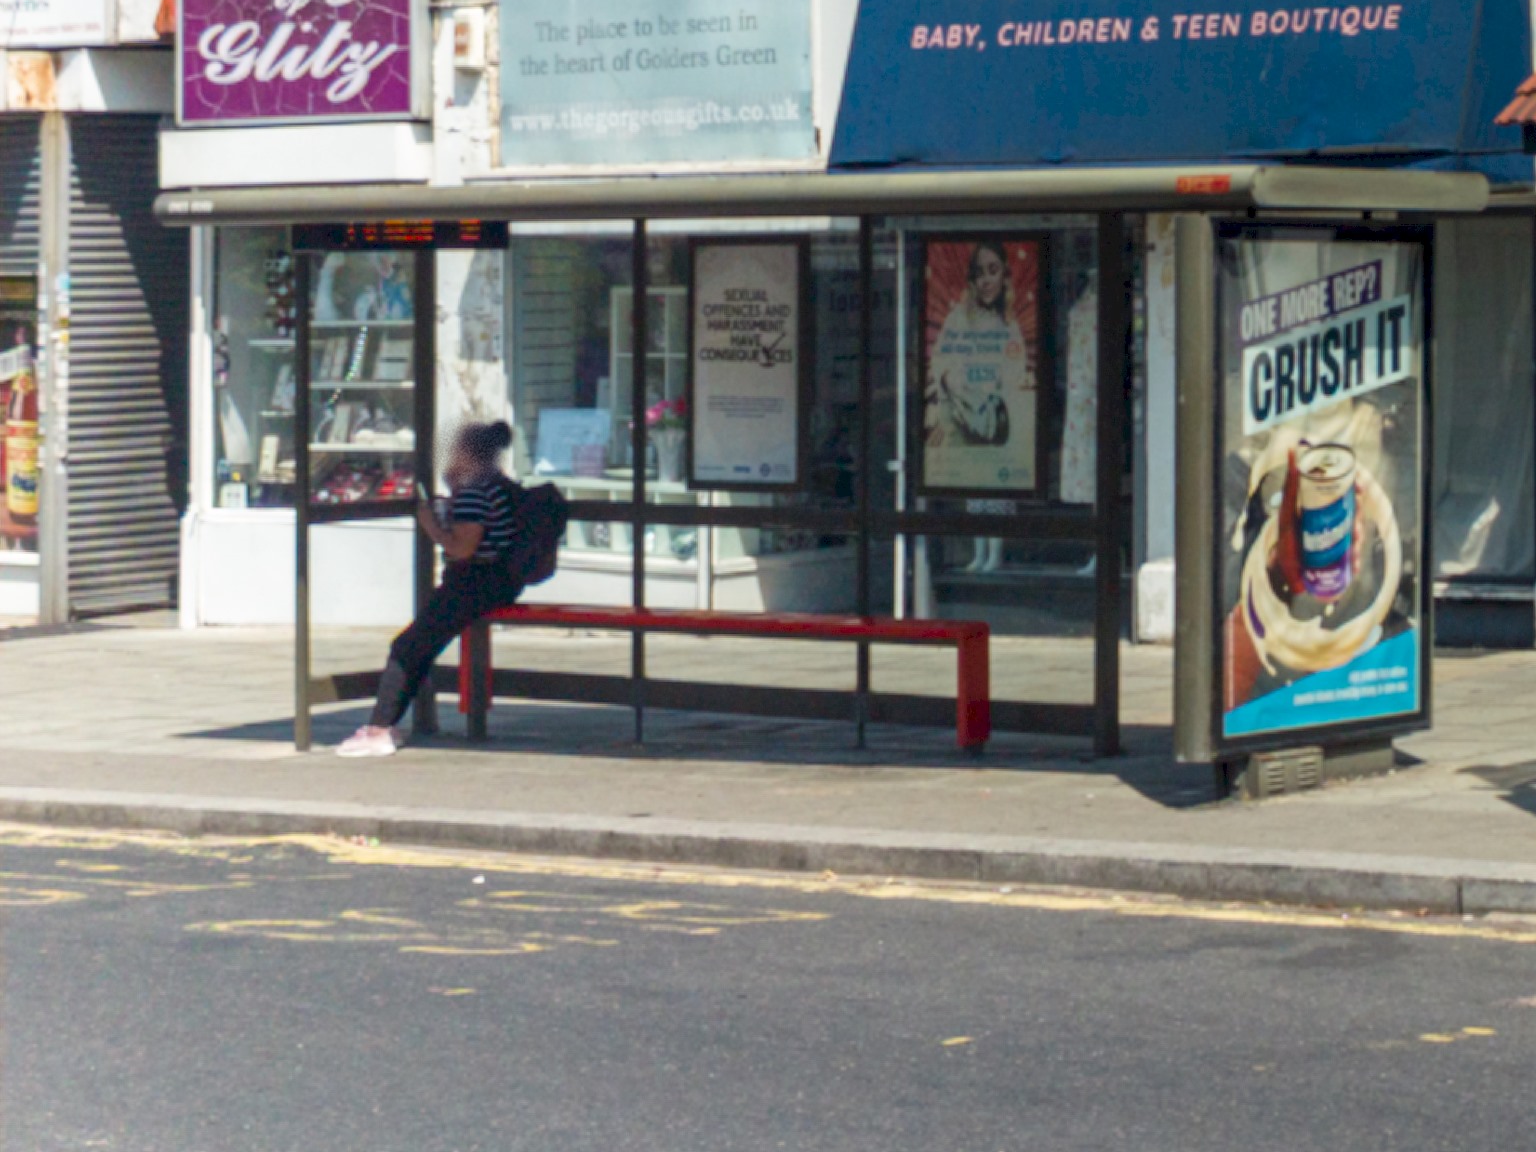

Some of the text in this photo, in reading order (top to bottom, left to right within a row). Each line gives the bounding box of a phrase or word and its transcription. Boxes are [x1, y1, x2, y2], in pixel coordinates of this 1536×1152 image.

[535, 8, 758, 46] The place to be seen in
[910, 4, 1403, 53] BABY, CHILDREN & TEEN BOUTIQUE
[198, 18, 399, 105] Glitz
[520, 44, 777, 77] the heart of Golders Green
[1240, 265, 1377, 343] ONE MORE REP?
[1250, 307, 1406, 423] CRUSH IT
